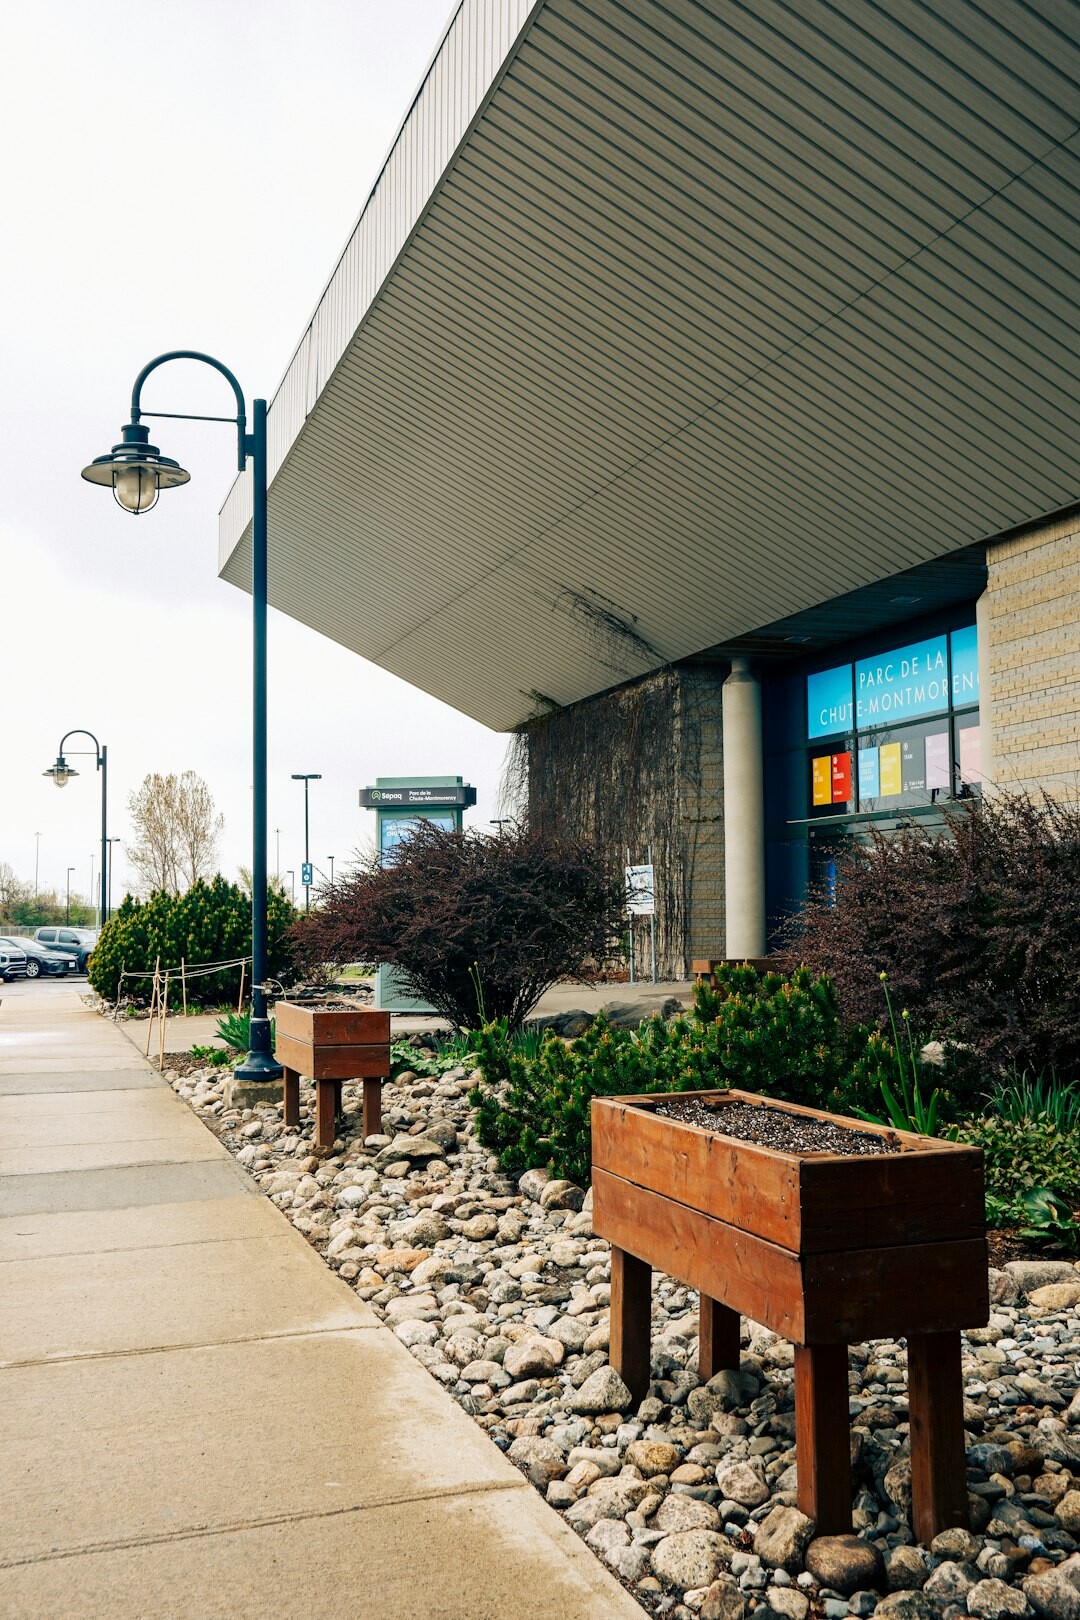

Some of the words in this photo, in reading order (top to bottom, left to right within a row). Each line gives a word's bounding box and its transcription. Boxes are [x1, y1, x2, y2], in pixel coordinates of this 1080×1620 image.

[859, 664, 895, 690] PARC
[901, 656, 919, 679] DE
[927, 650, 945, 672] LA
